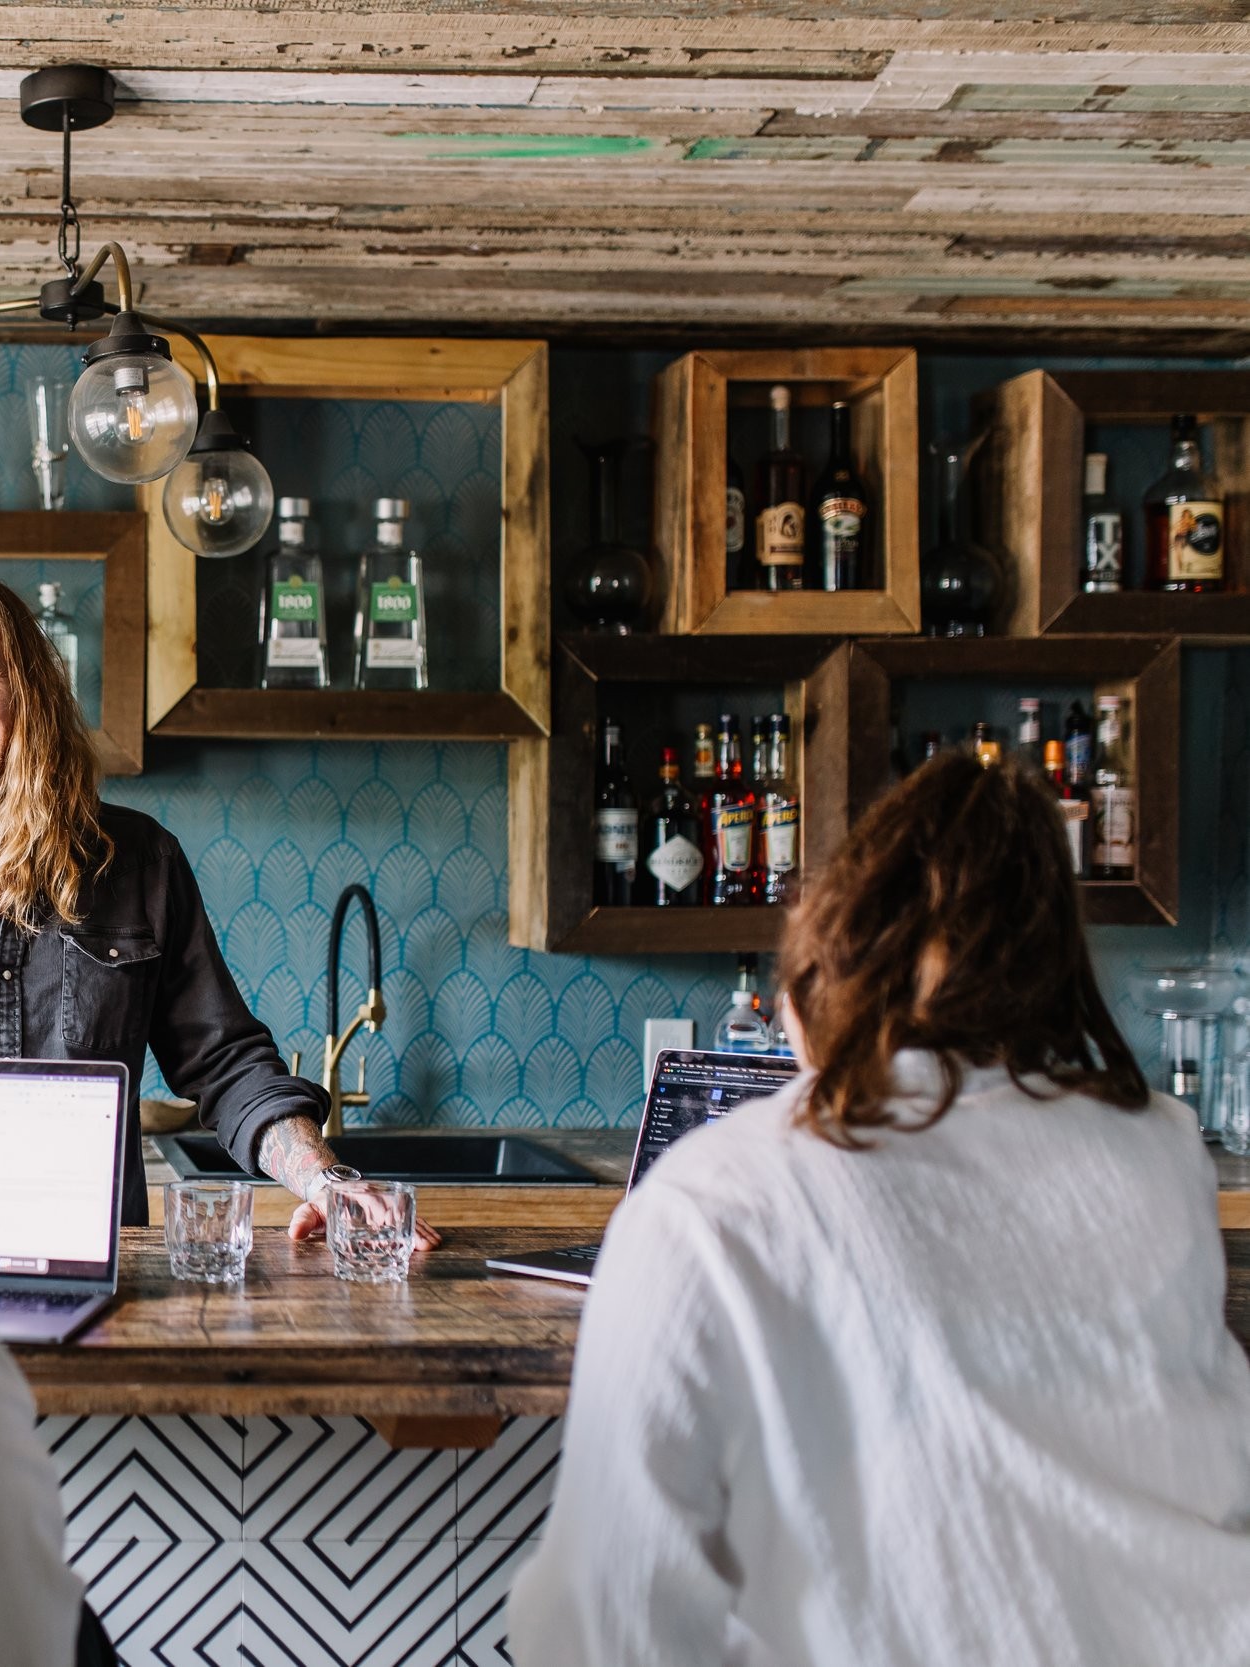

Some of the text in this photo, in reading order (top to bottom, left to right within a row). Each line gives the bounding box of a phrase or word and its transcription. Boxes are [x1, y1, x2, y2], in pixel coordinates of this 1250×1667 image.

[278, 593, 313, 609] 1800
[377, 594, 412, 610] 1800
[719, 808, 754, 826] APERO
[761, 808, 799, 827] APERO
